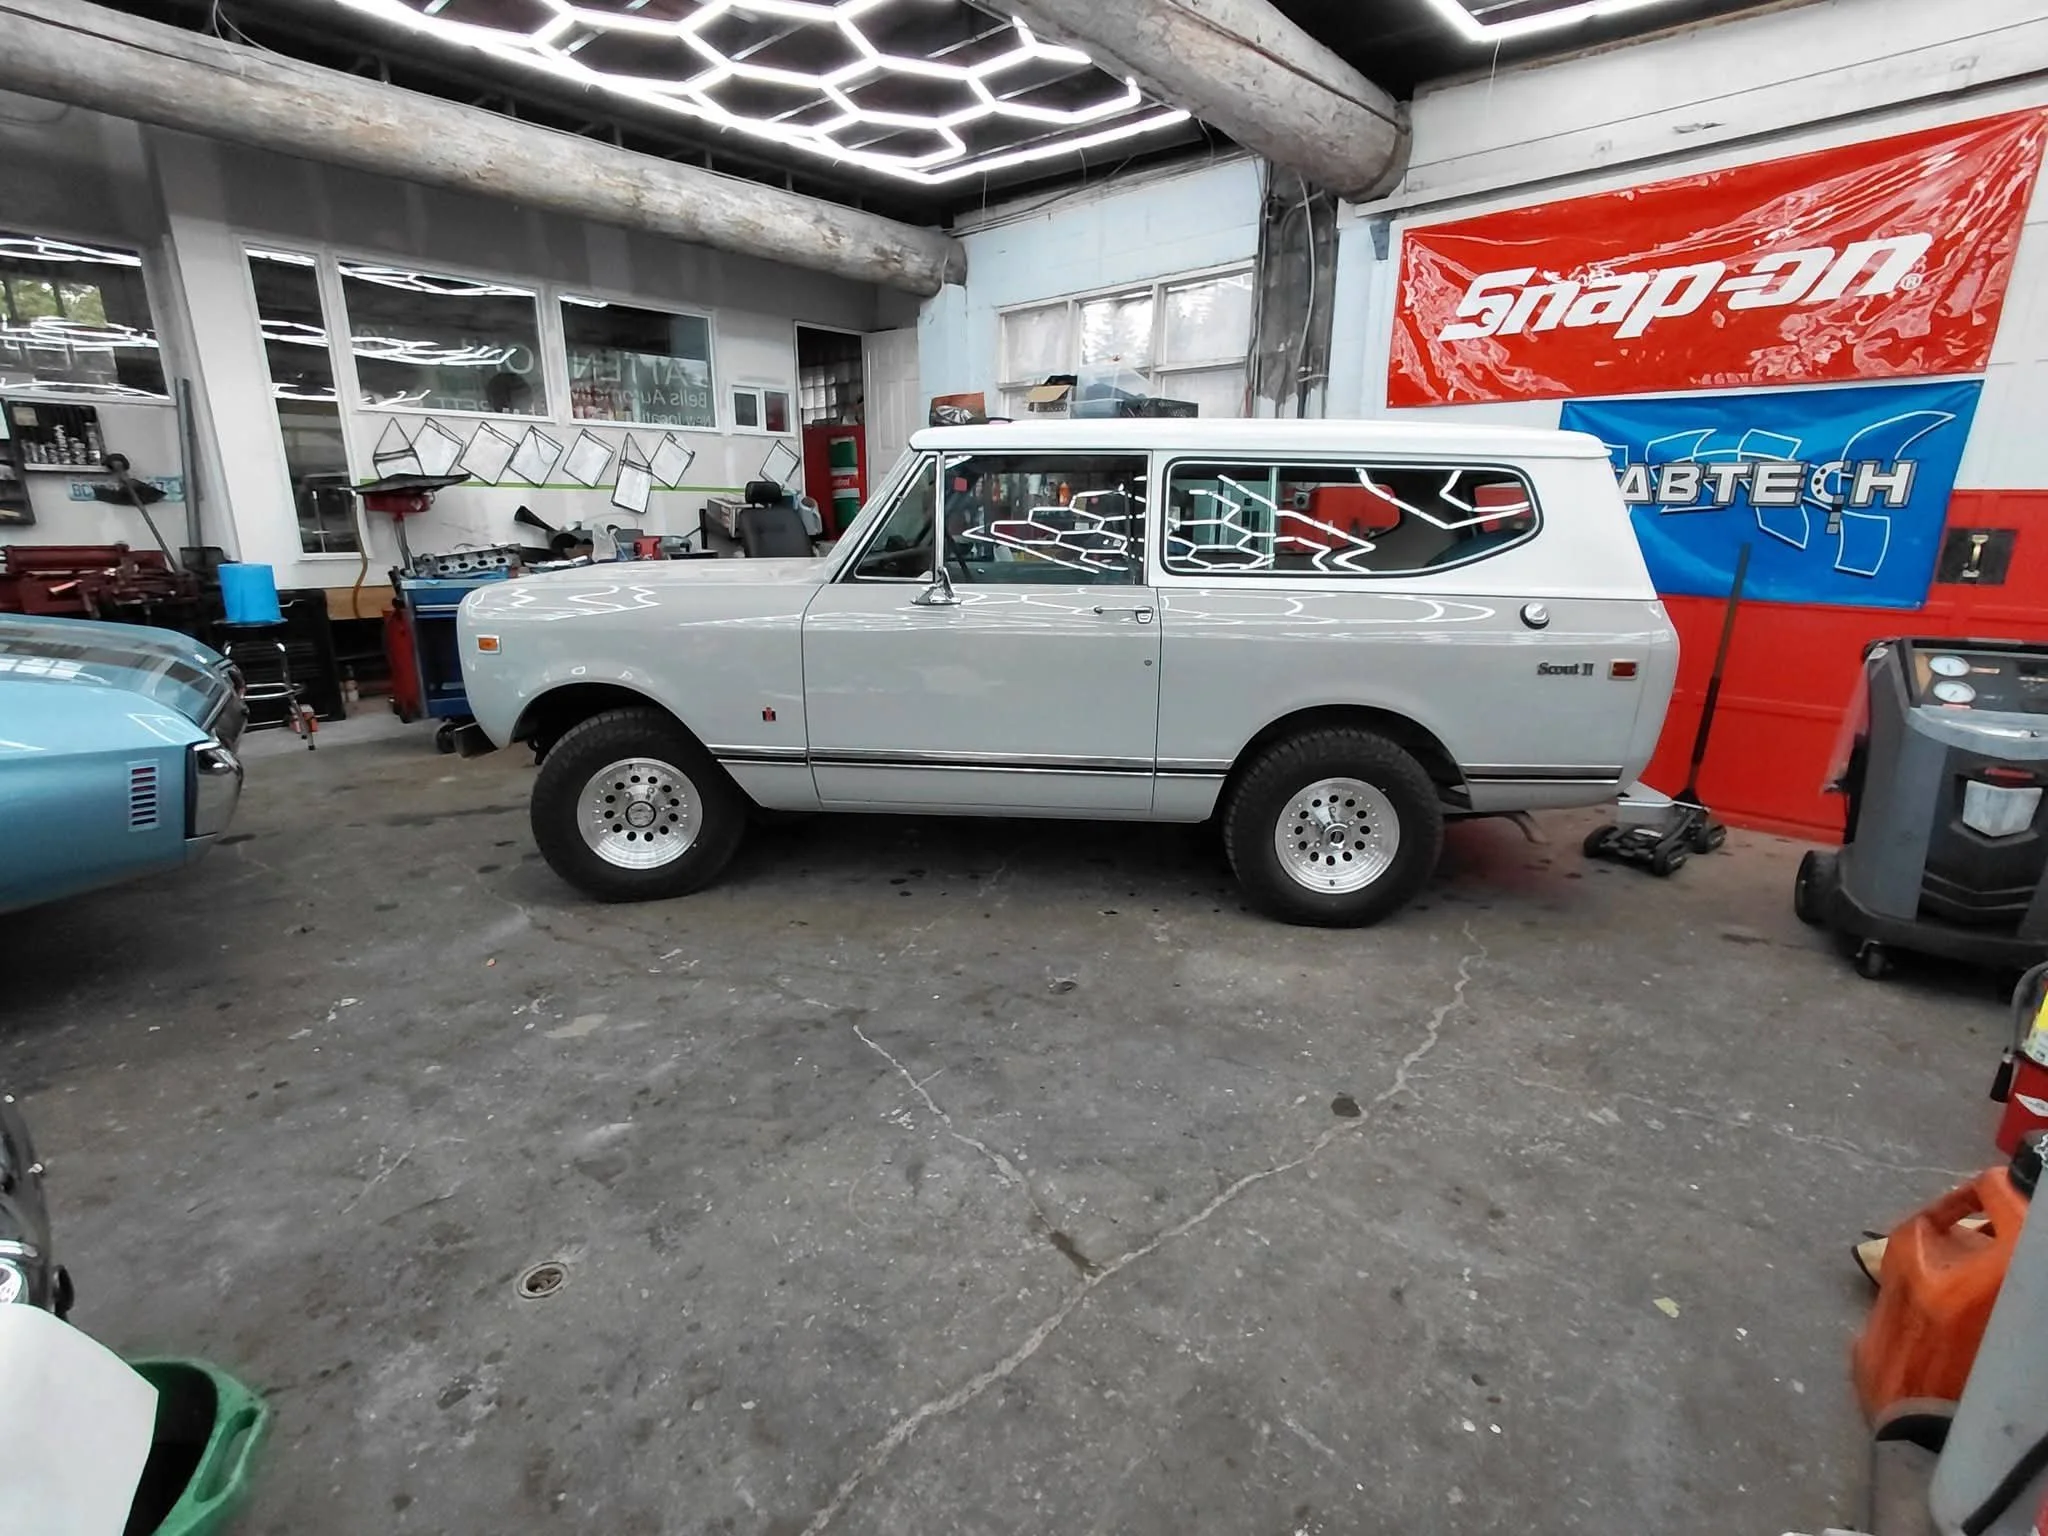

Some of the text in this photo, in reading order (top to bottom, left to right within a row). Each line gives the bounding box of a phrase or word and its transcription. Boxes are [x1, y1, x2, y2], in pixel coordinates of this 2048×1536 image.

[1438, 233, 1933, 341] Snap-on
[1612, 459, 1918, 509] ABTECH
[1537, 662, 1579, 675] Scout
